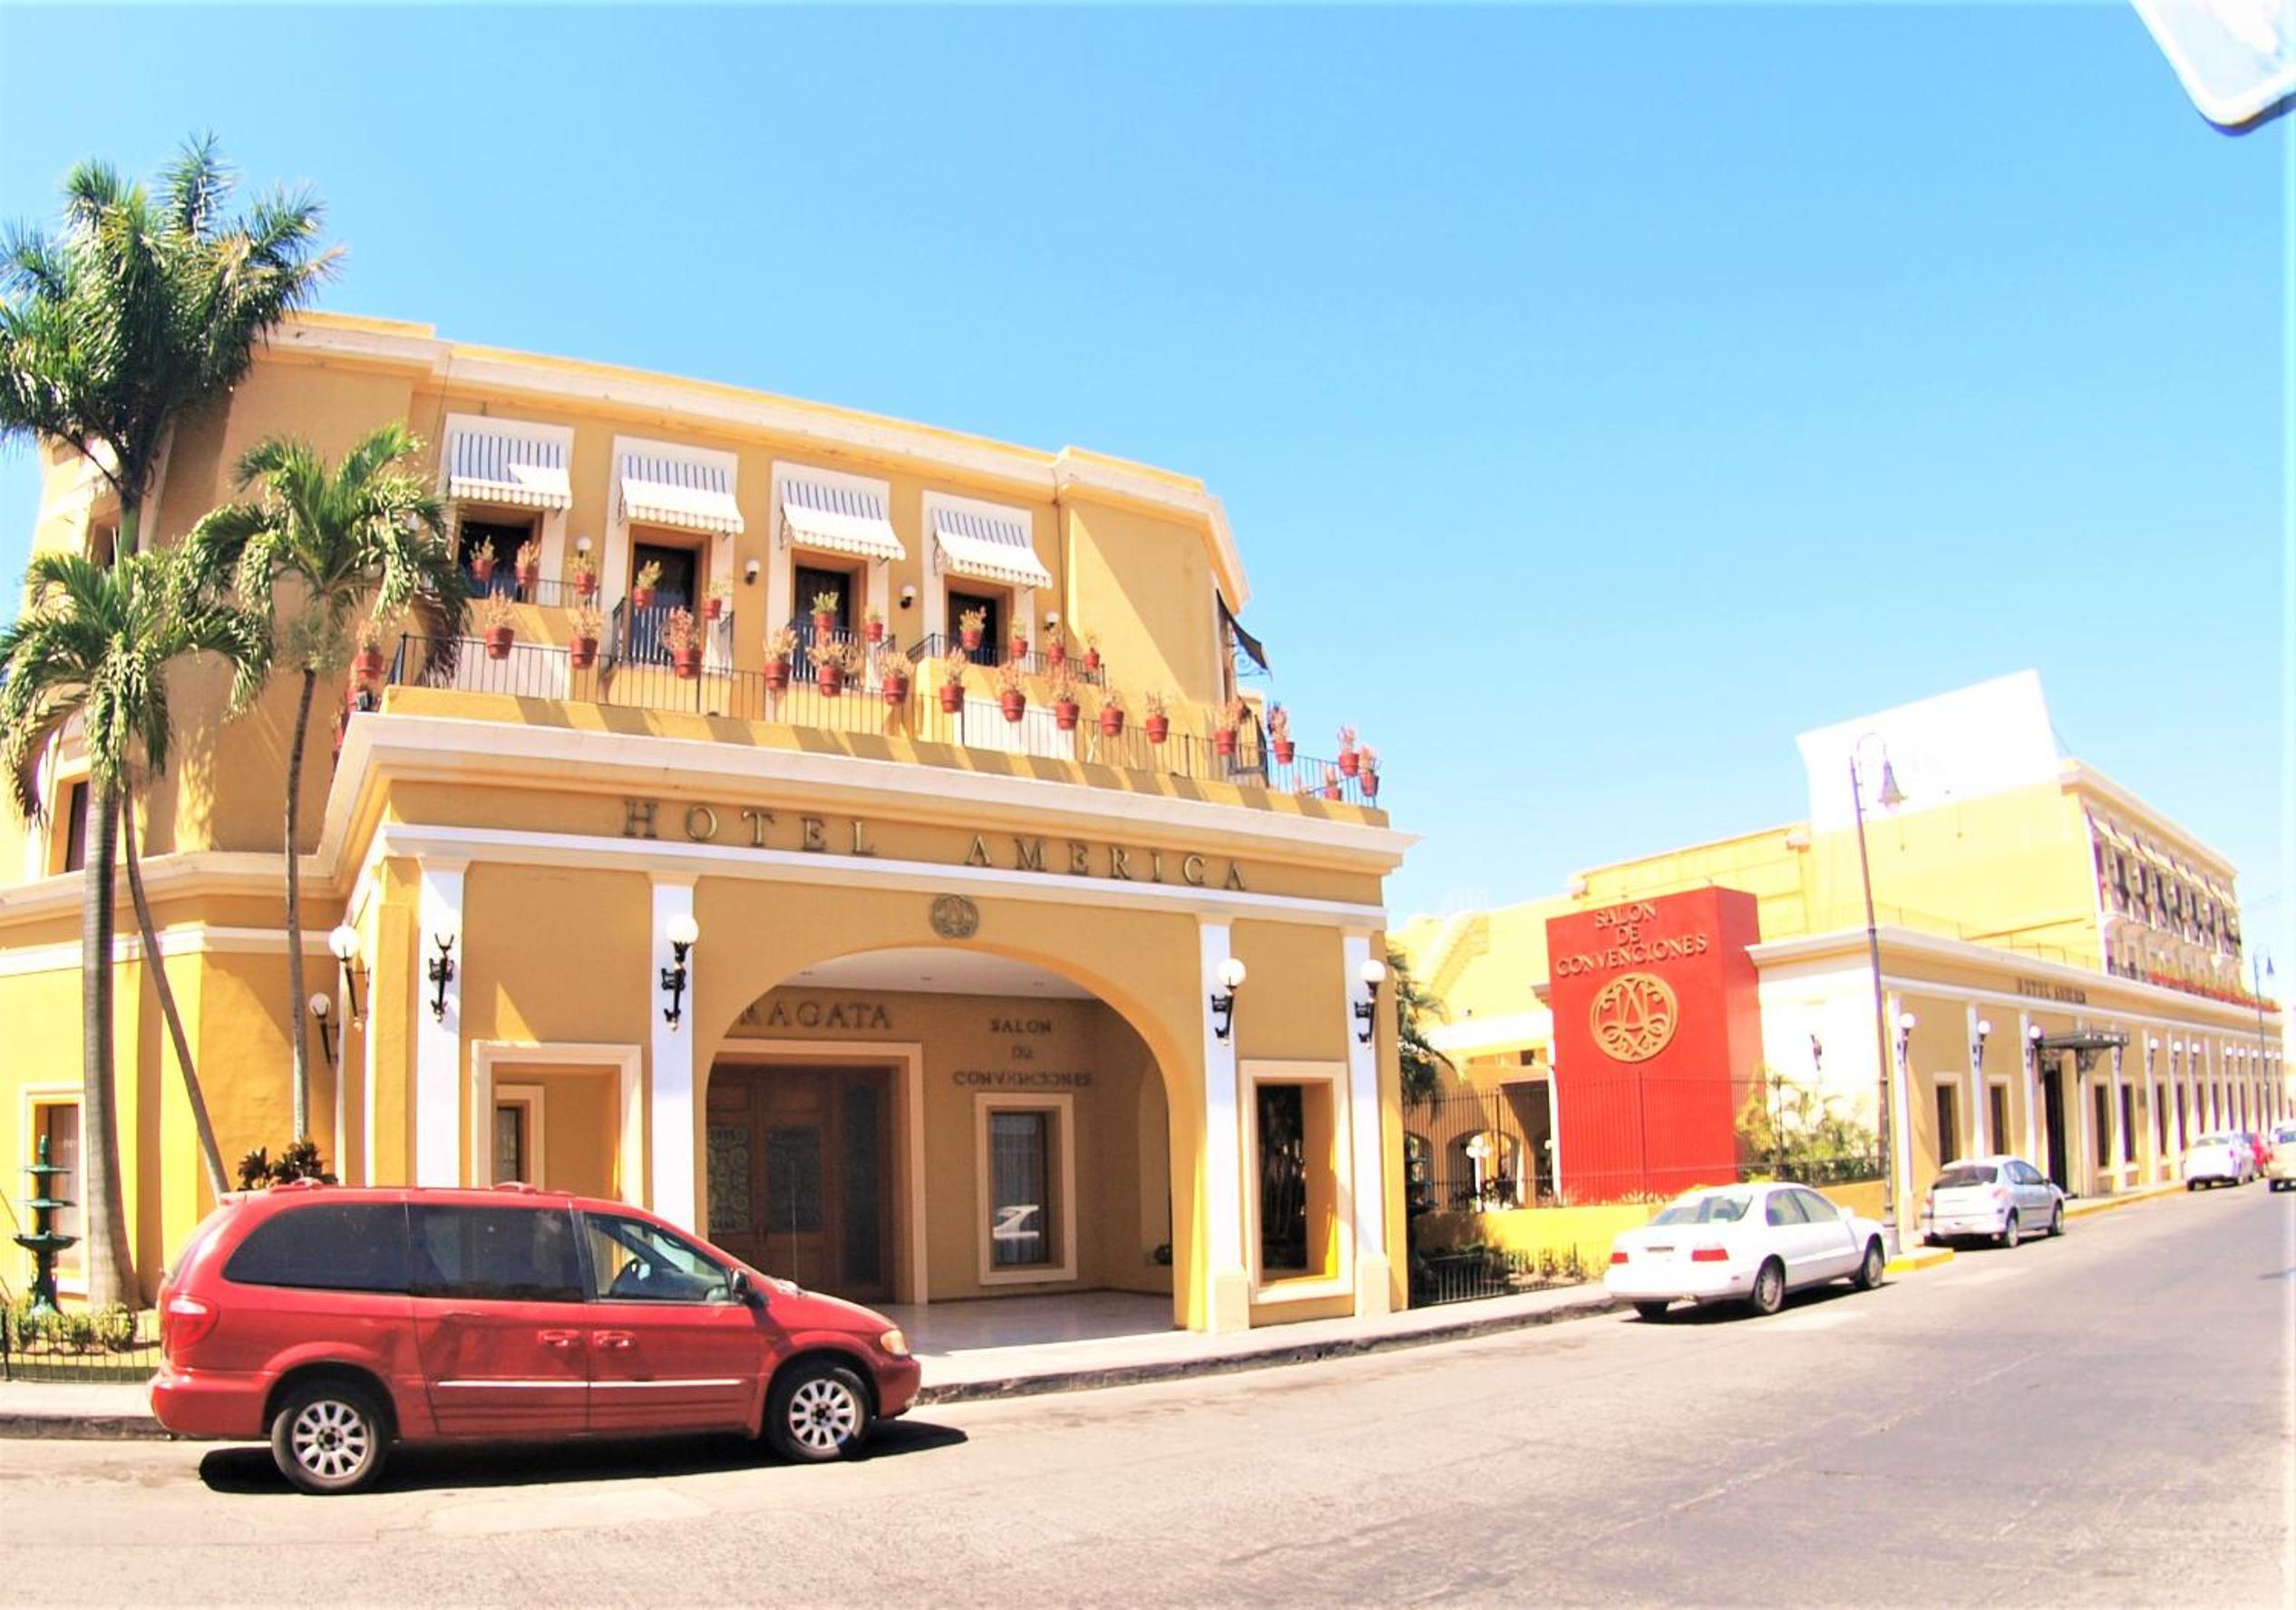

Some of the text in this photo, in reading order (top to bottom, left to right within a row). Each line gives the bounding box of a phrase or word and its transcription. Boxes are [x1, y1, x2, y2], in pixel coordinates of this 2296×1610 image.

[623, 797, 1247, 891] HOTEL AMERICA
[1594, 901, 1658, 930] SALON
[1616, 925, 1641, 946] DE
[1556, 934, 1708, 978] CONVENCIONES
[990, 1019, 1052, 1033] SALON
